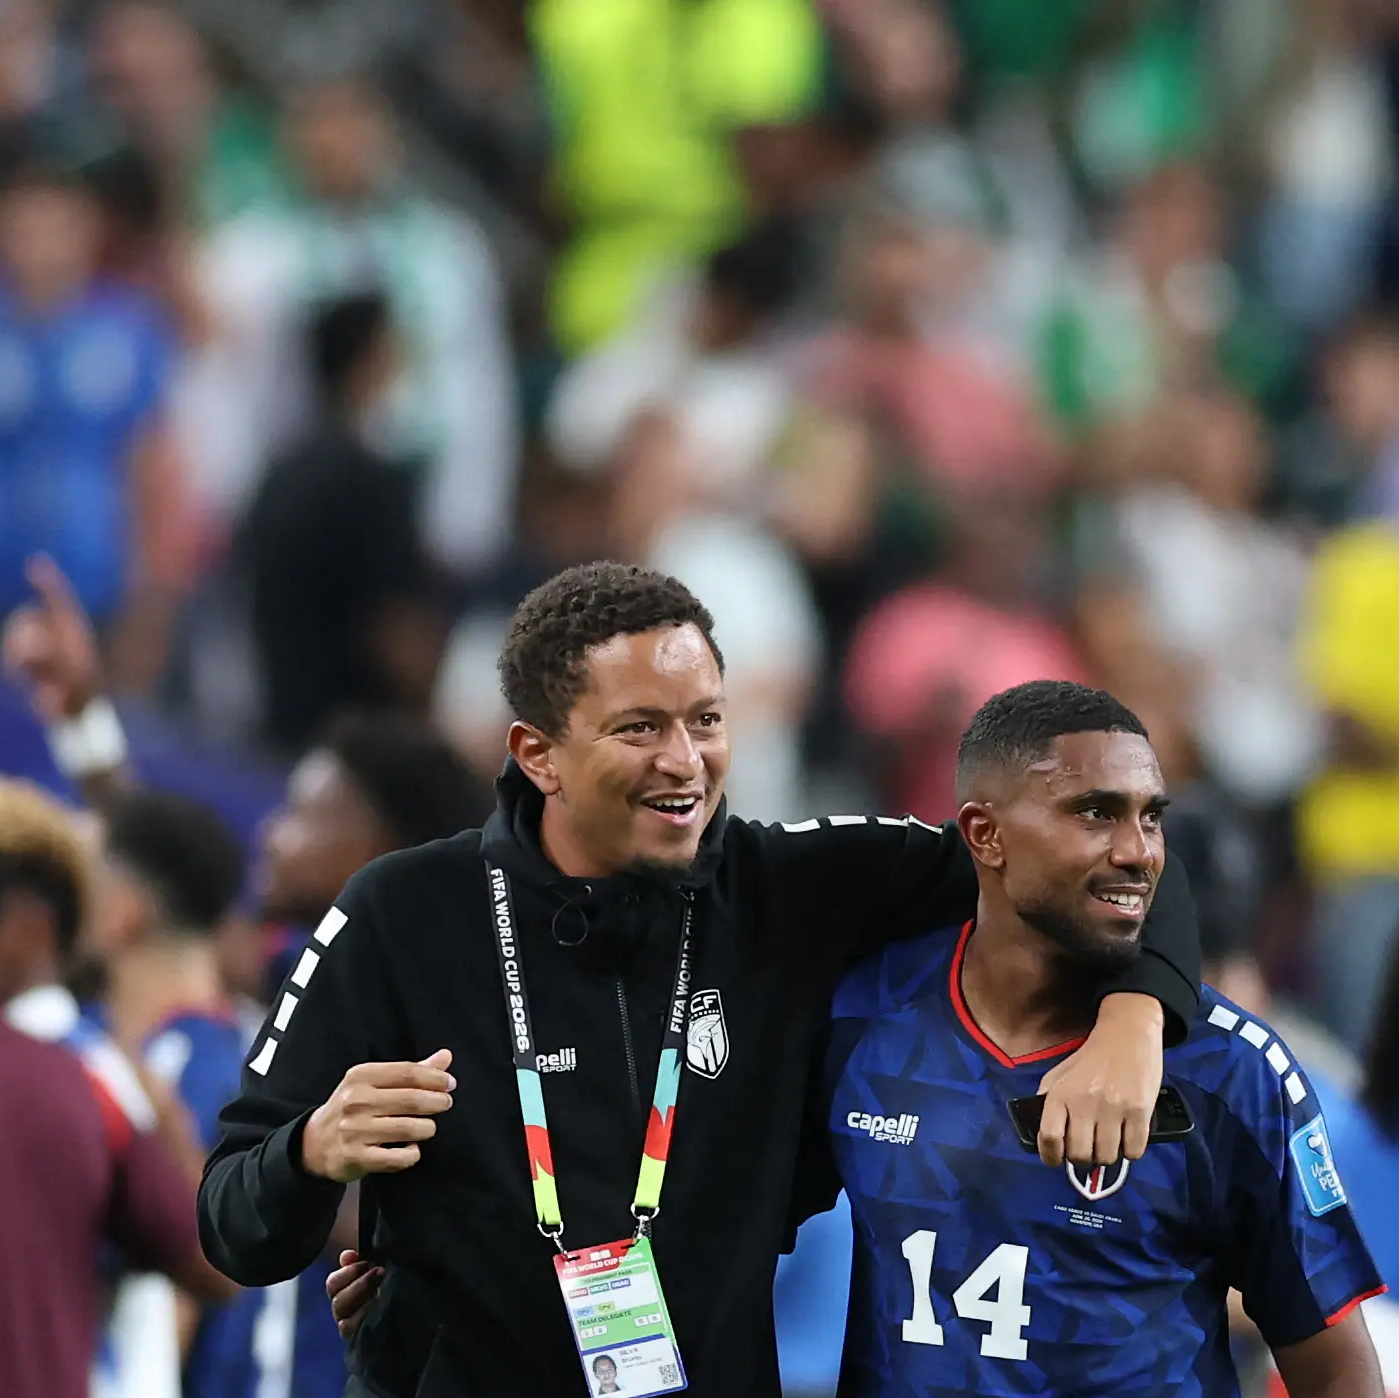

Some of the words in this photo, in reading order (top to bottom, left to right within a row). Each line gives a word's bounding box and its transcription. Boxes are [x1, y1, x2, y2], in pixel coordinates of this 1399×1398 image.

[491, 868, 507, 902] FIFA
[495, 901, 516, 958] WORLD
[504, 960, 521, 993] CUP
[669, 999, 687, 1034] FIFA
[689, 994, 718, 1014] CF
[534, 1047, 577, 1072] pelli
[542, 1064, 577, 1074] SPORT
[847, 1111, 920, 1138] capelli
[874, 1131, 914, 1146] SPORT
[901, 1228, 1031, 1361] 14
[578, 1317, 597, 1327] TEAM
[598, 1311, 632, 1323] DELEGATE
